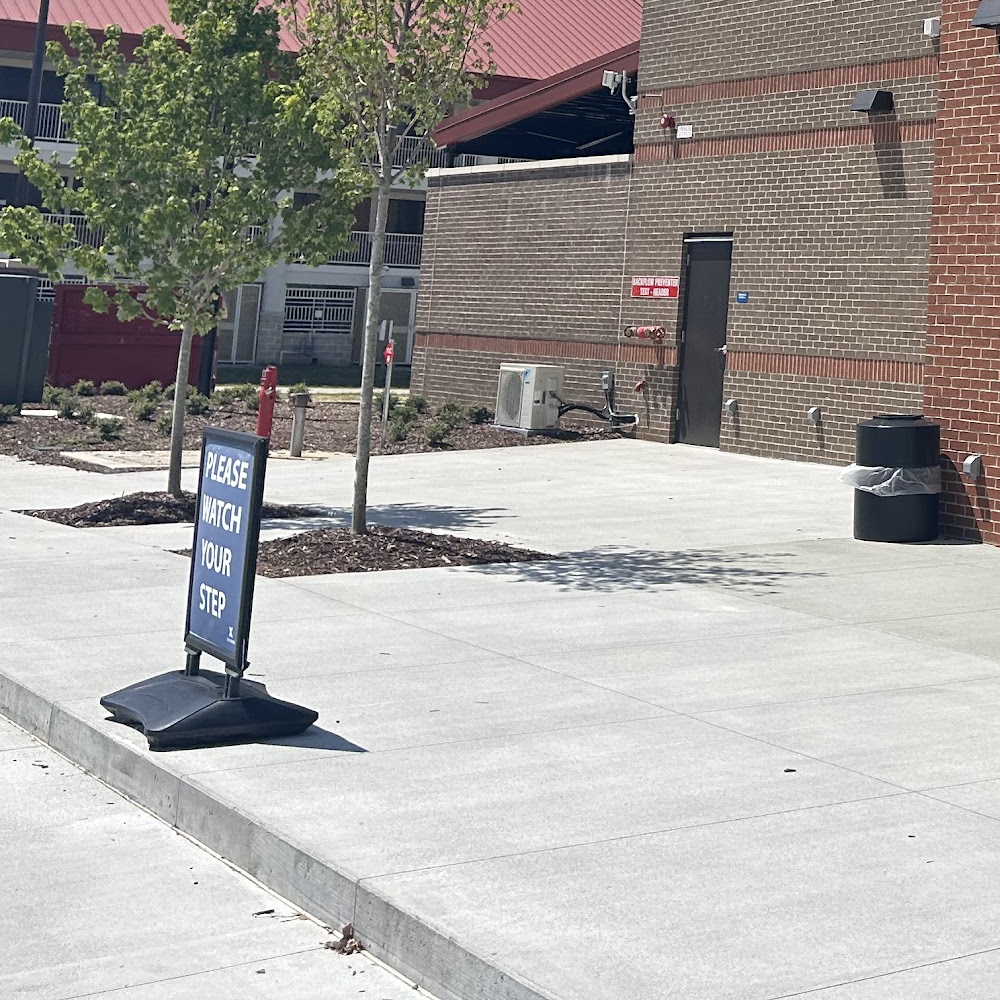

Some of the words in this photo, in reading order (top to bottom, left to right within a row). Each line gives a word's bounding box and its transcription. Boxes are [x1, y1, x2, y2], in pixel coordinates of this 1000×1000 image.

[205, 451, 250, 490] PLEASE
[202, 493, 243, 535] WATCH
[200, 537, 232, 578] YOUR
[199, 582, 227, 619] STEP
